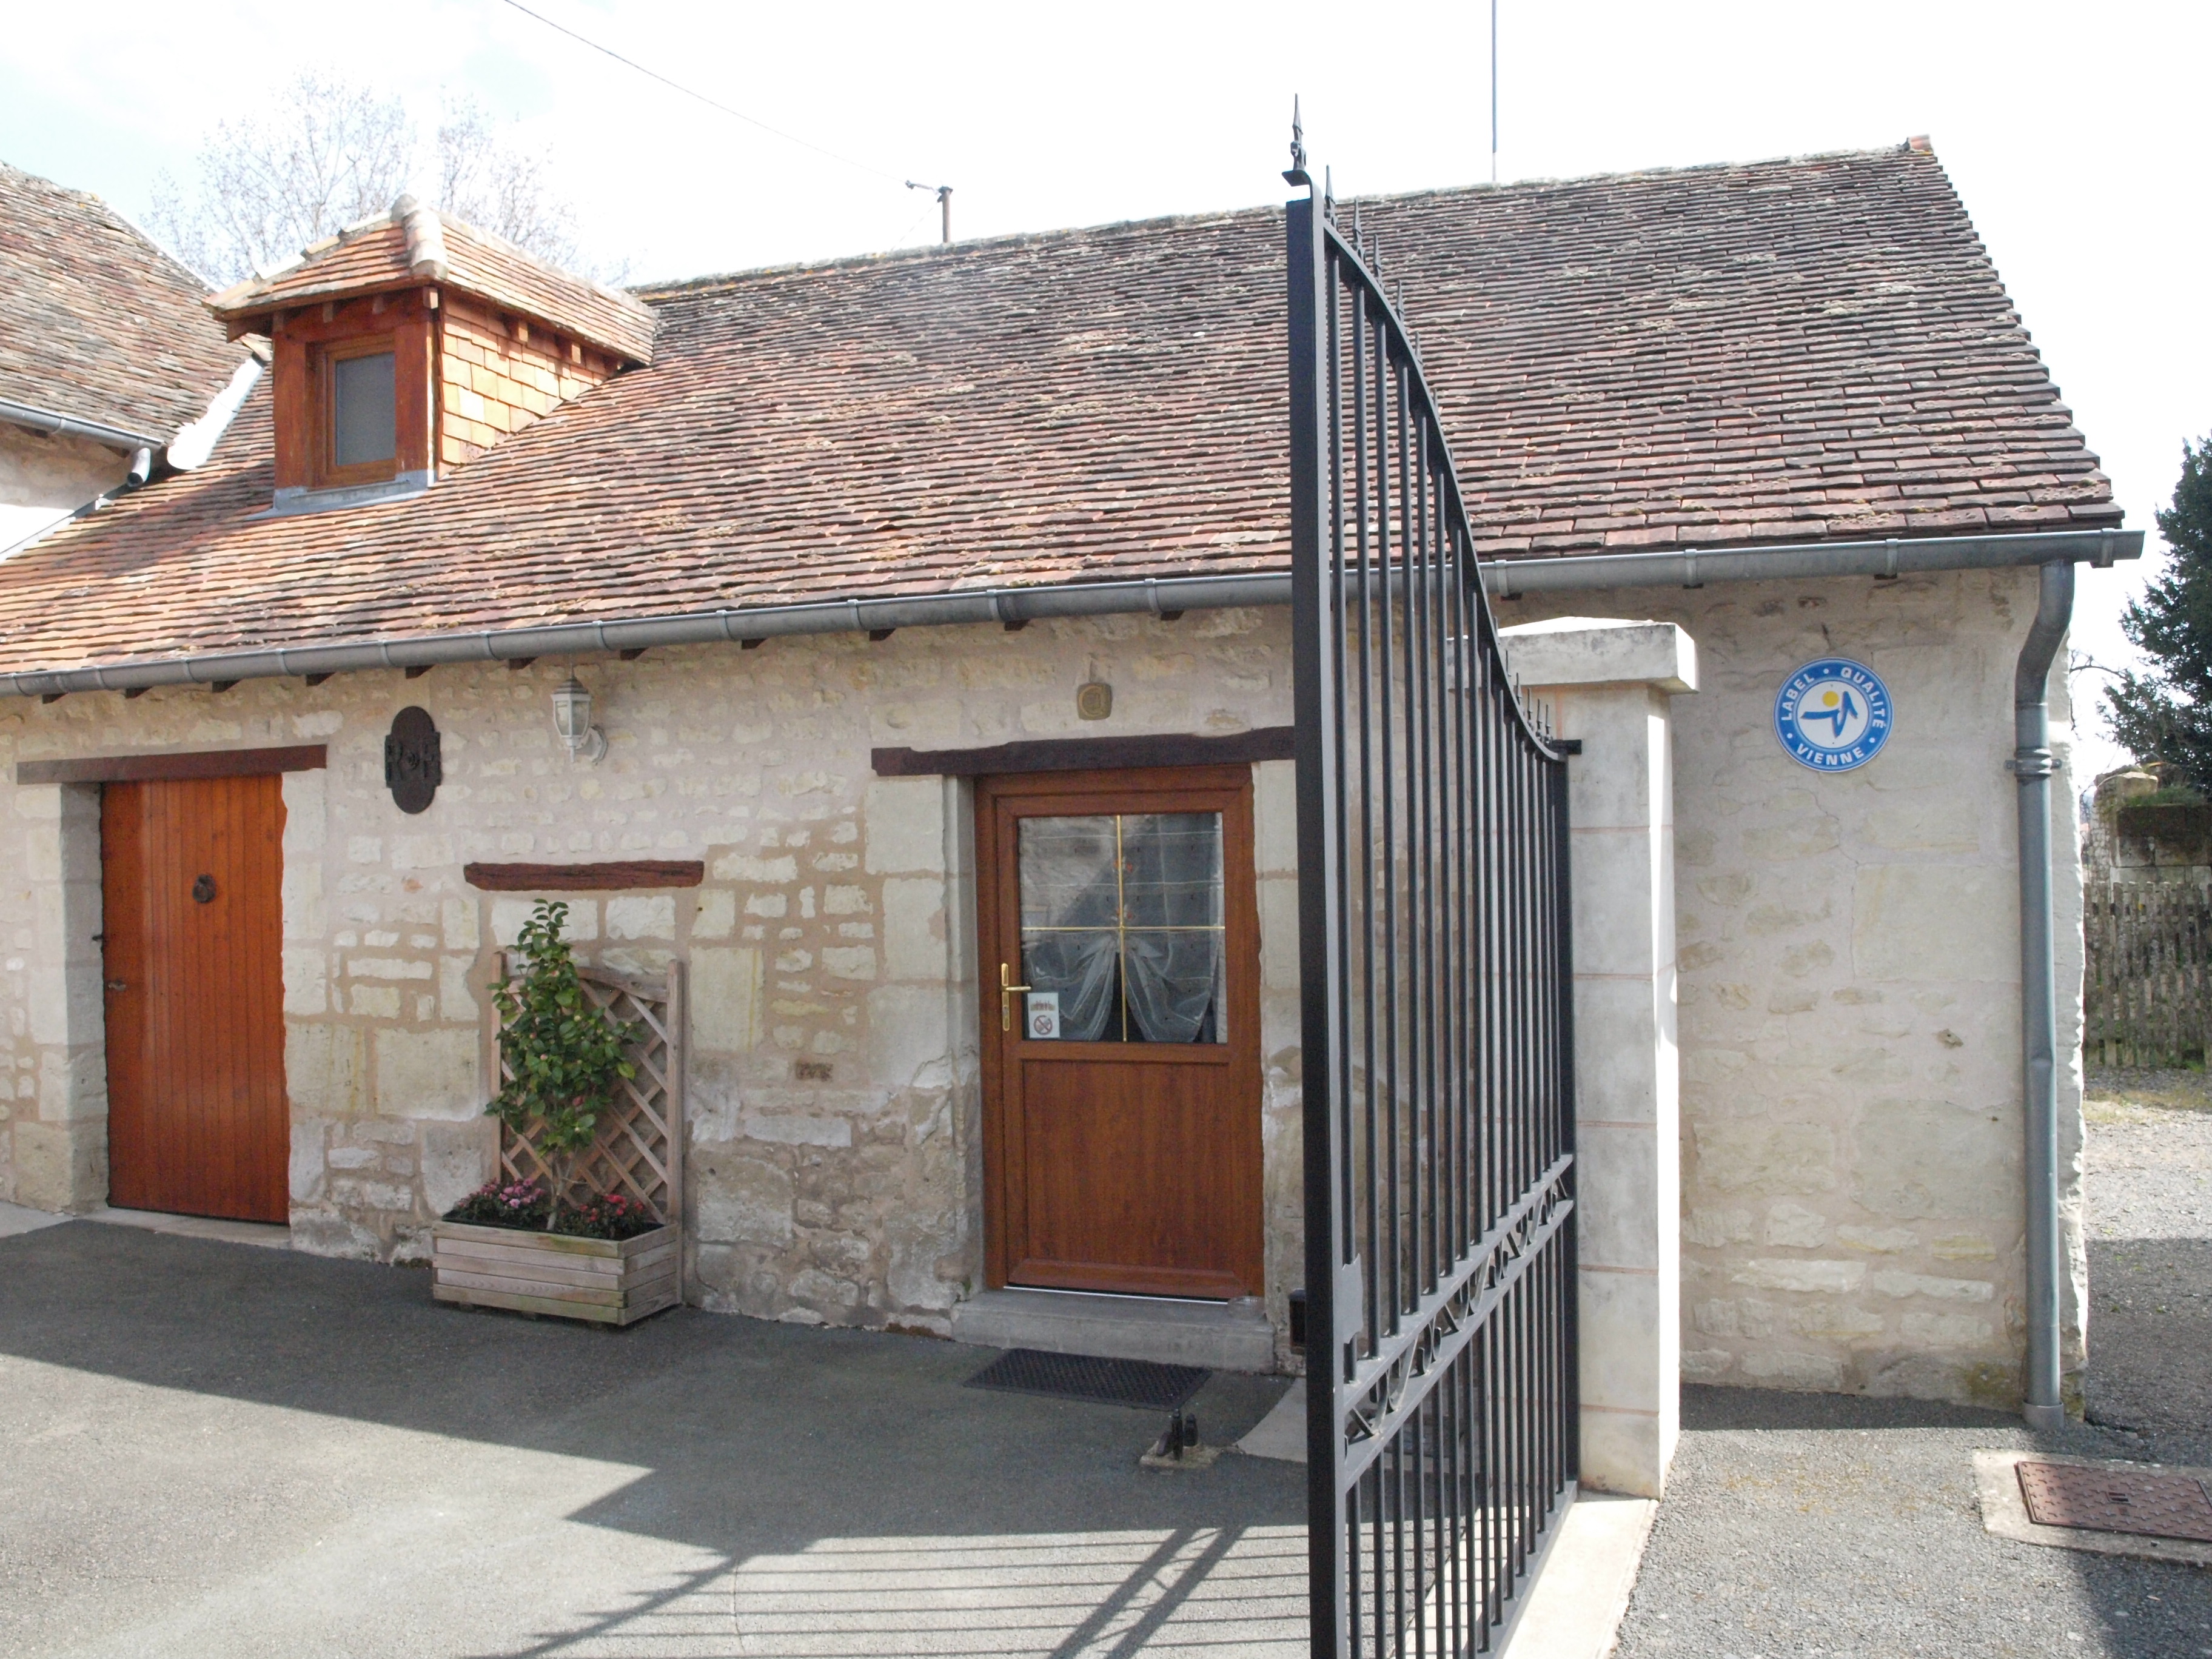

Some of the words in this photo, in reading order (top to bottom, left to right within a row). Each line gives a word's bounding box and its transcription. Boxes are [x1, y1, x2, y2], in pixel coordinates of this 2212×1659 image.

[1781, 673, 1814, 721] LABEL
[1840, 666, 1886, 729] QUALITÉ
[1797, 743, 1864, 765] VIENNE
